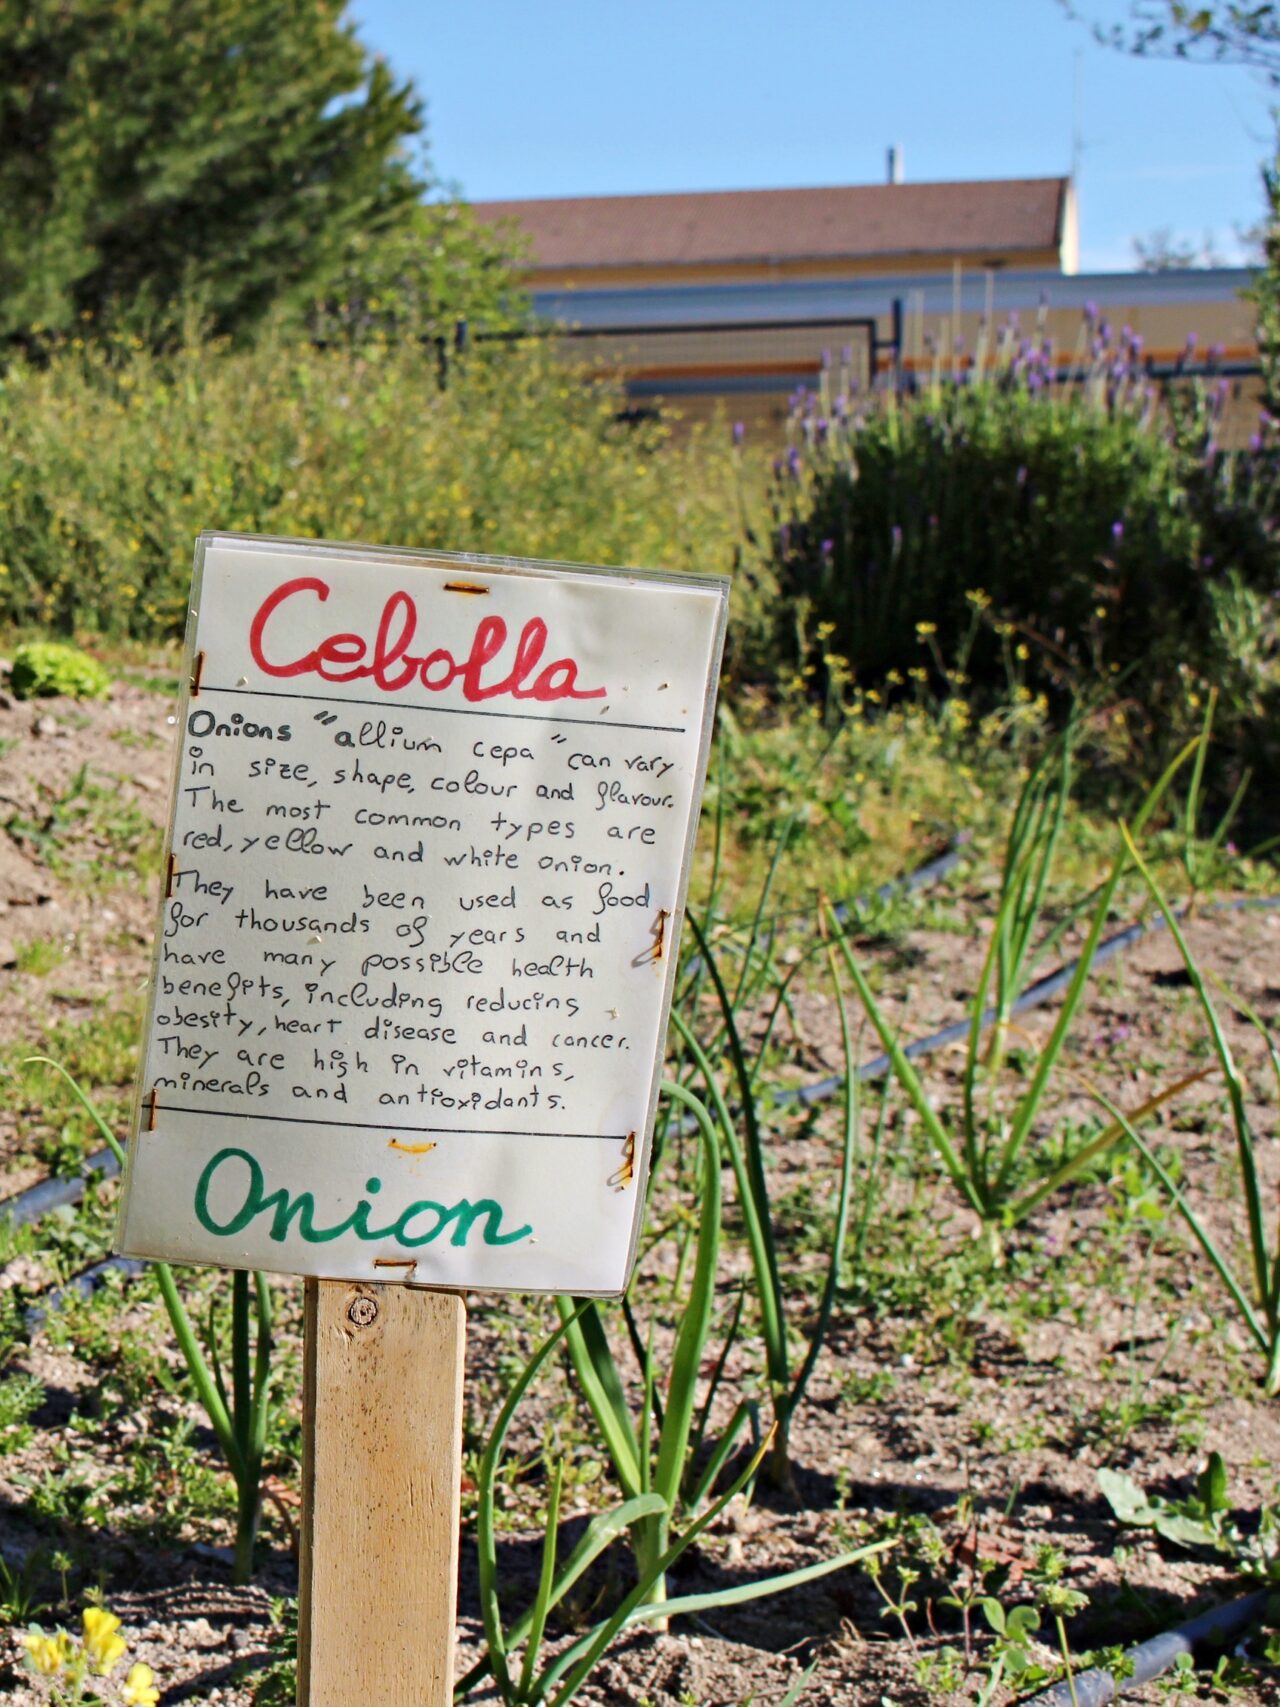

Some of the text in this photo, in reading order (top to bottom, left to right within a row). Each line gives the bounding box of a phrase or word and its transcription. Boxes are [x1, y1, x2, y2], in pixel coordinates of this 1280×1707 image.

[249, 575, 608, 703] Cebolla
[188, 710, 292, 742] Onions
[568, 753, 610, 770] can
[625, 756, 674, 777] vary
[189, 746, 674, 811] in size, shape, colour and flavour.
[185, 786, 655, 844] The most common types are
[374, 841, 424, 863] and
[444, 845, 519, 869] white
[538, 855, 625, 876] onion.
[172, 870, 650, 915] They have been used as food
[164, 901, 601, 948] for thousands of years and
[164, 943, 593, 978] have many possible health
[162, 971, 580, 1017] benefits, including reducing
[156, 1002, 267, 1037] obesity,
[274, 1015, 342, 1034] heart
[364, 1016, 457, 1045] disease
[482, 1024, 528, 1047] and
[156, 1035, 575, 1082] They are high in vitamins,
[153, 1071, 566, 1111] minerals and antioxidants.
[194, 1146, 534, 1249] Onion
